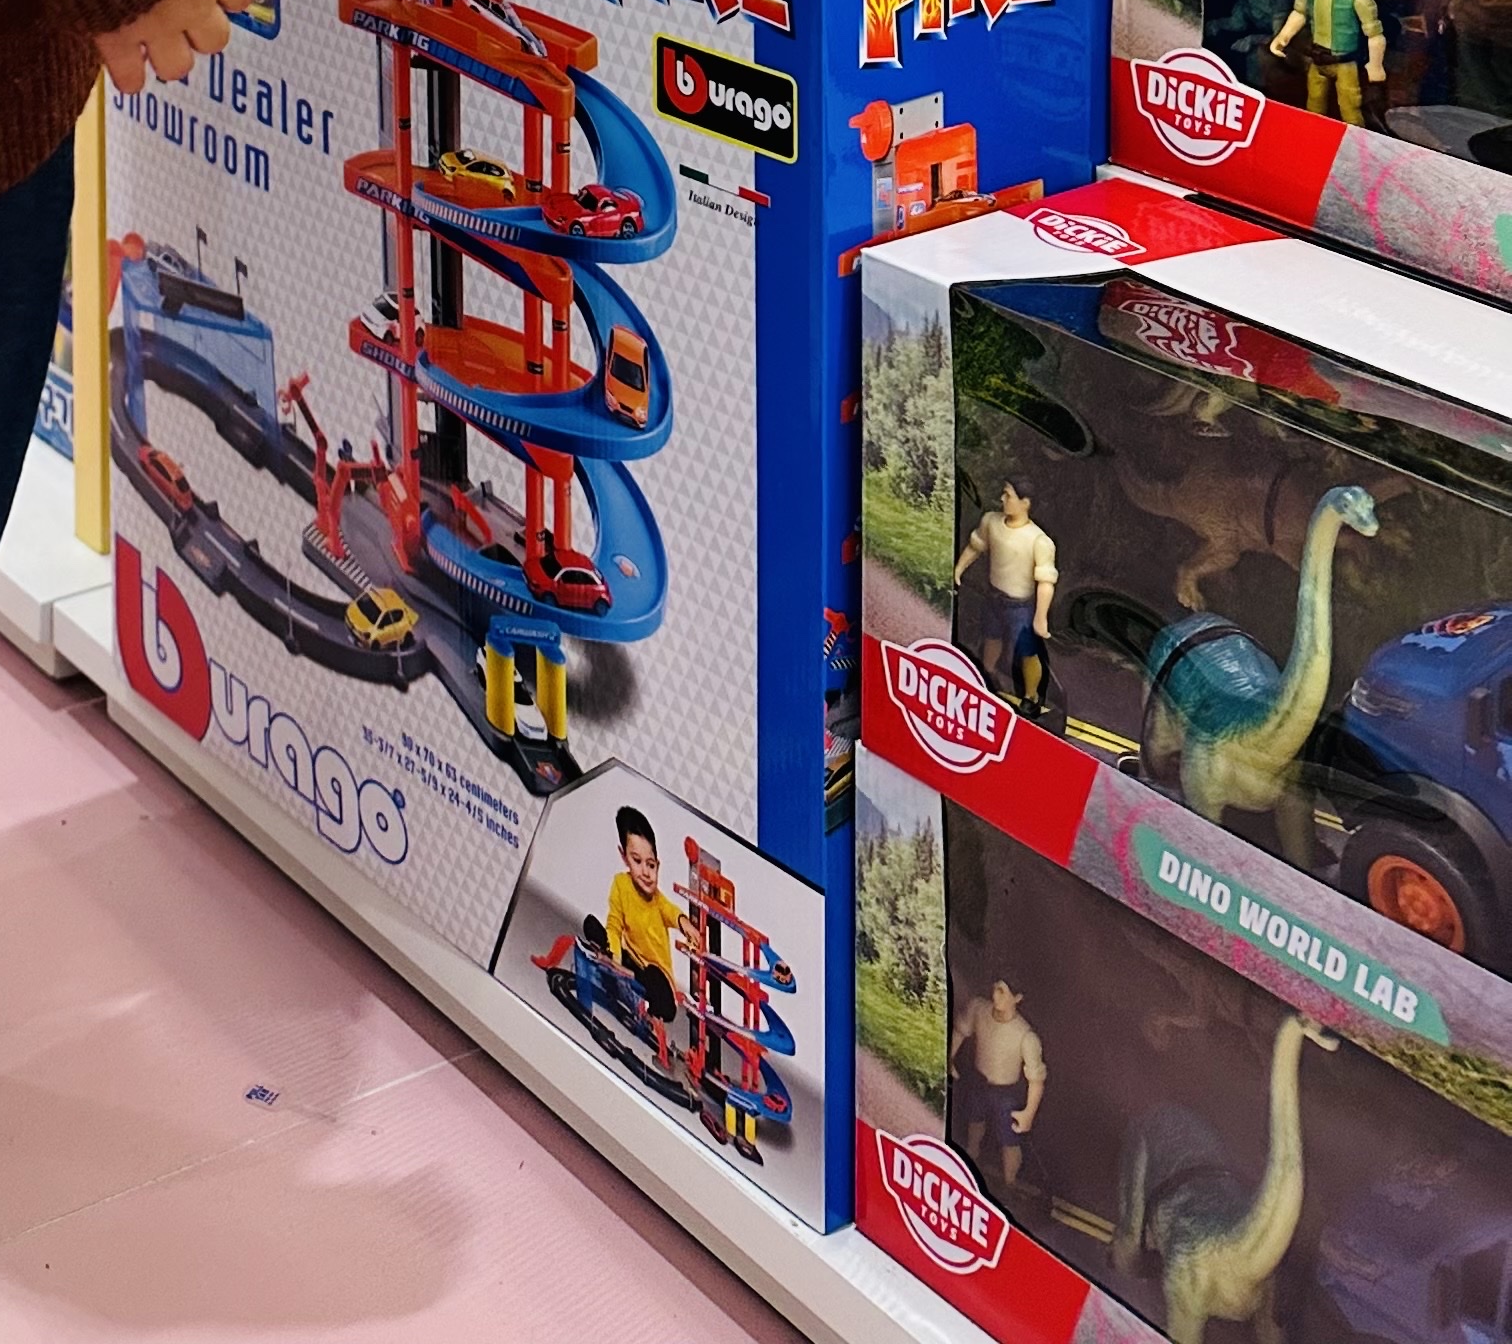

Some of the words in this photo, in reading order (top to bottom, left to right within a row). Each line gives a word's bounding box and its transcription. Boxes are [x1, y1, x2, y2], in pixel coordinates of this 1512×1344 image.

[210, 51, 333, 154] Dealer
[1174, 116, 1212, 138] TOYS
[689, 190, 722, 212] Italian
[926, 710, 965, 741] TOYS
[424, 747, 435, 767] 70
[446, 763, 457, 782] 63
[460, 775, 519, 825] centimeters
[487, 814, 519, 848] inches
[1159, 851, 1230, 914] DINO
[1238, 896, 1347, 983] WORLD
[1354, 963, 1419, 1024] LAB
[922, 1205, 957, 1242] TOYS
